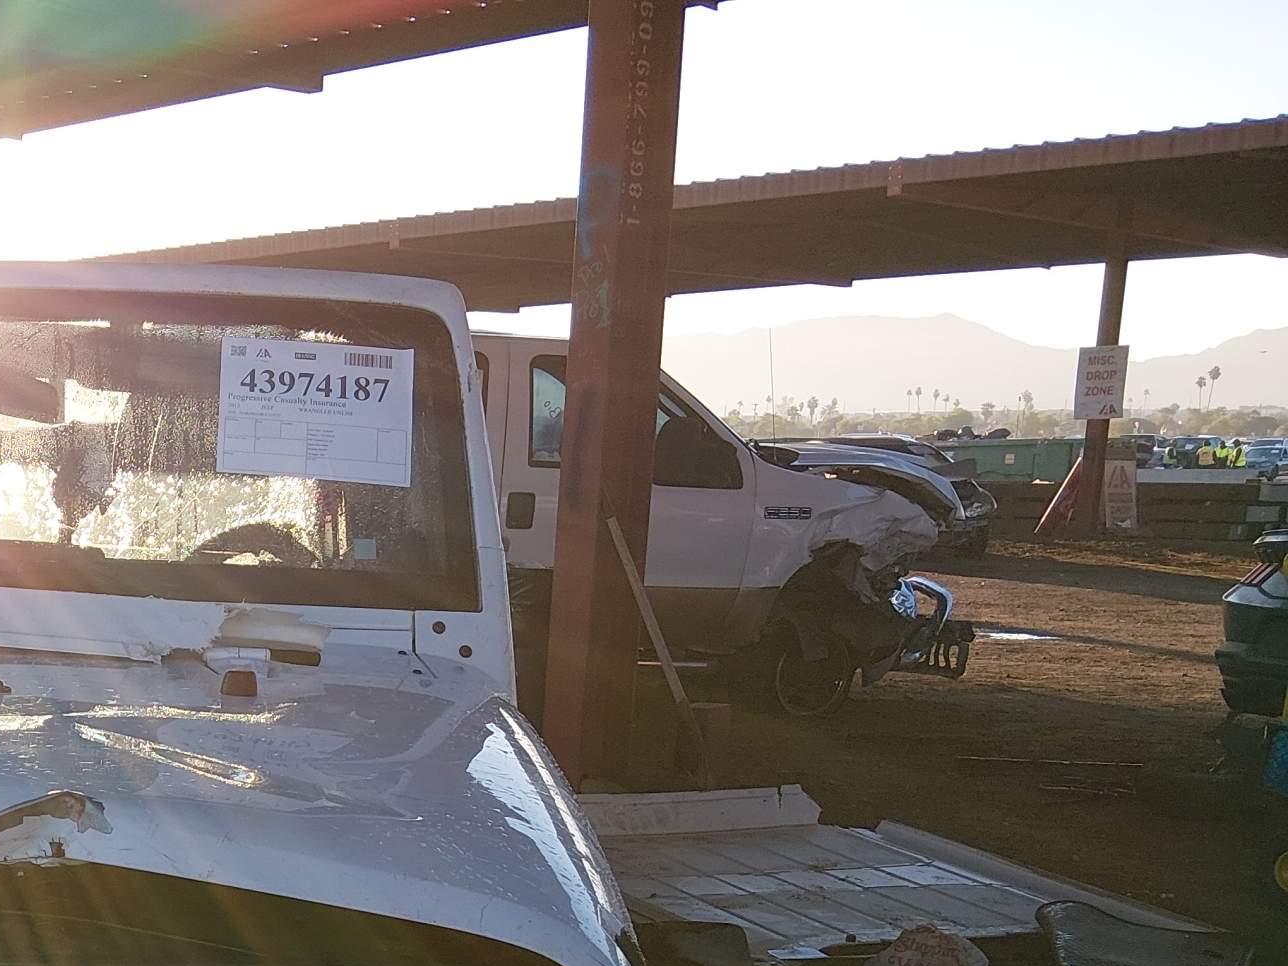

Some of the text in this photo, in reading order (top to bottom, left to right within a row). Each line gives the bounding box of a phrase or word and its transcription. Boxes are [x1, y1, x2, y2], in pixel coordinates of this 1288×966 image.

[1085, 370, 1117, 381] DROP
[240, 368, 390, 403] 43974187
[1084, 386, 1114, 397] ZONE
[228, 392, 347, 408] Progressive Casualty Insurance
